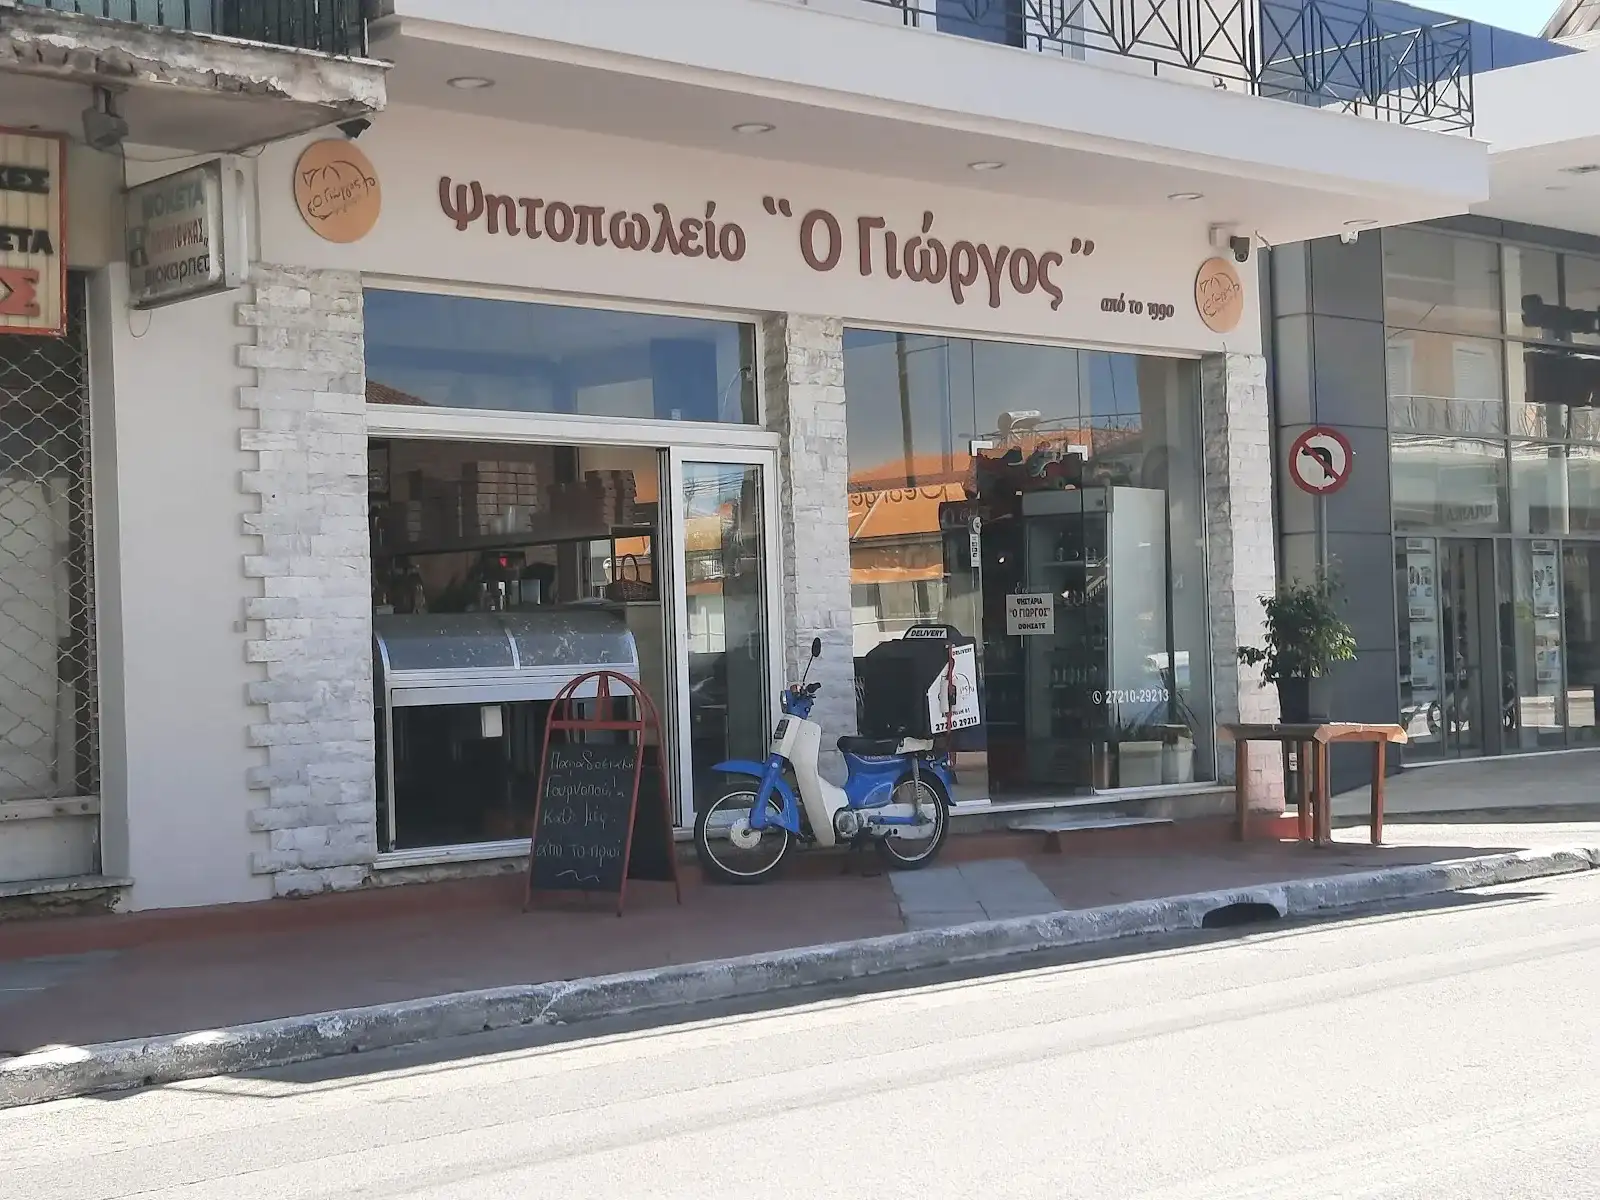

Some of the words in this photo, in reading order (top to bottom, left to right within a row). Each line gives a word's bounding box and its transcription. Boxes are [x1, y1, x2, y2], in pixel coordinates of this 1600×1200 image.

[438, 176, 747, 262] Ψητοπωλείο
[1100, 292, 1126, 314] από
[1127, 299, 1144, 316] το
[1146, 301, 1175, 321] 1990
[910, 629, 945, 637] DELIVERY
[1105, 688, 1169, 704] 27210-29213
